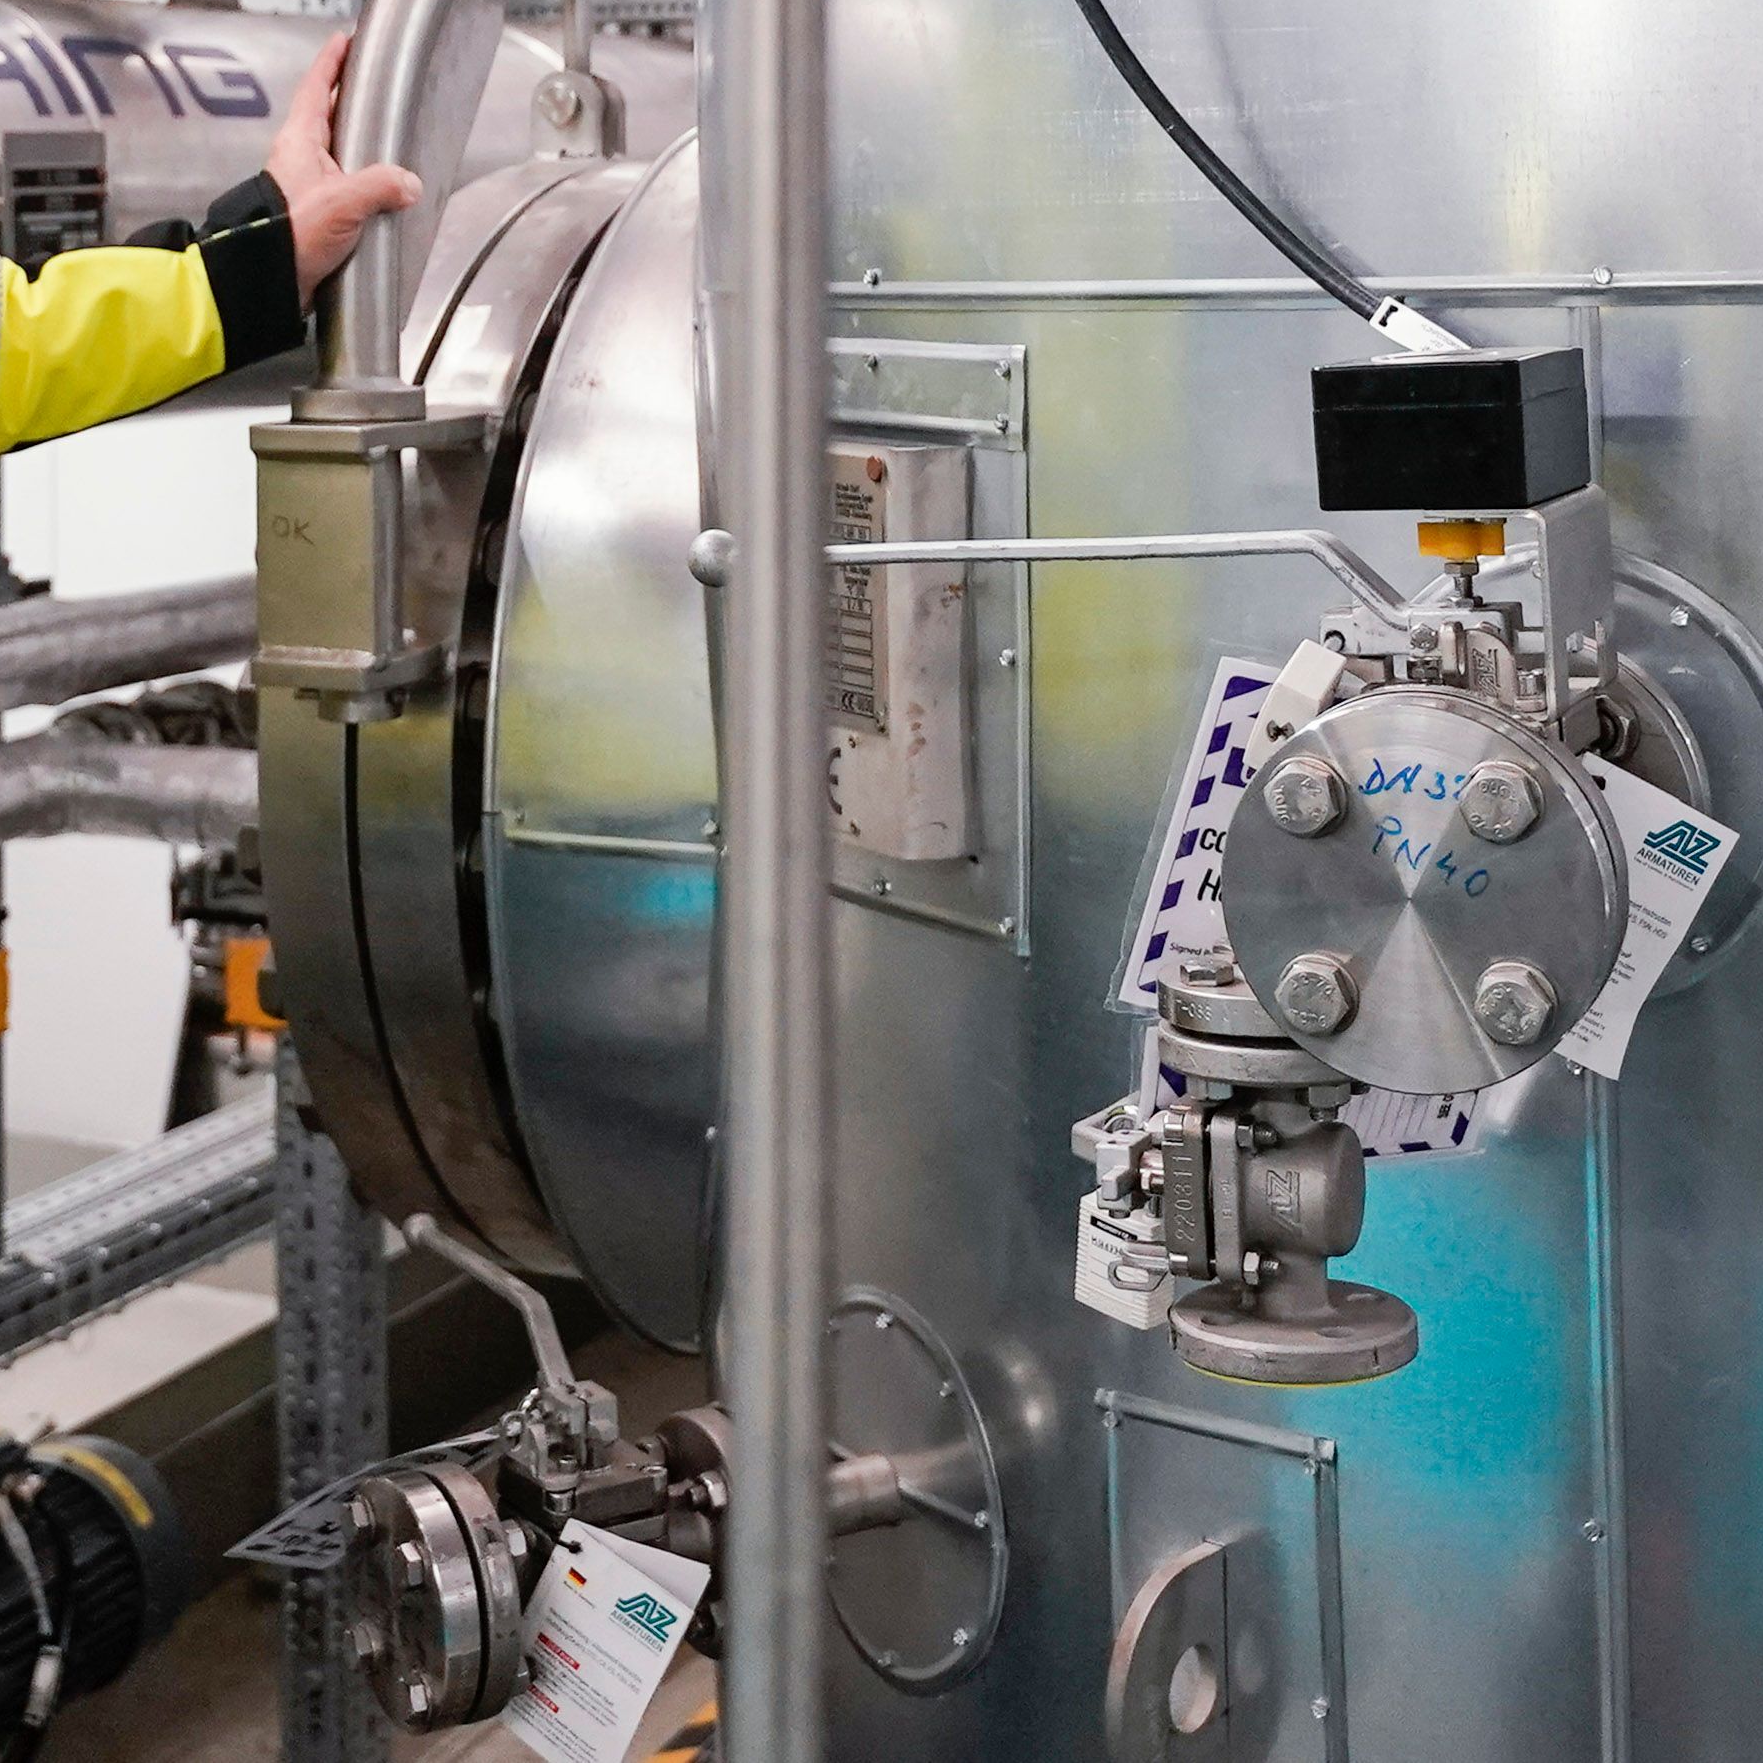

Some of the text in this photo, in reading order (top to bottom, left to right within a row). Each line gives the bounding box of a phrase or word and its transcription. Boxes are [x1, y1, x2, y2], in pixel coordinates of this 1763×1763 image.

[272, 515, 316, 546] OK
[1636, 847, 1701, 887] ARMATUREN
[1169, 942, 1201, 956] Signed
